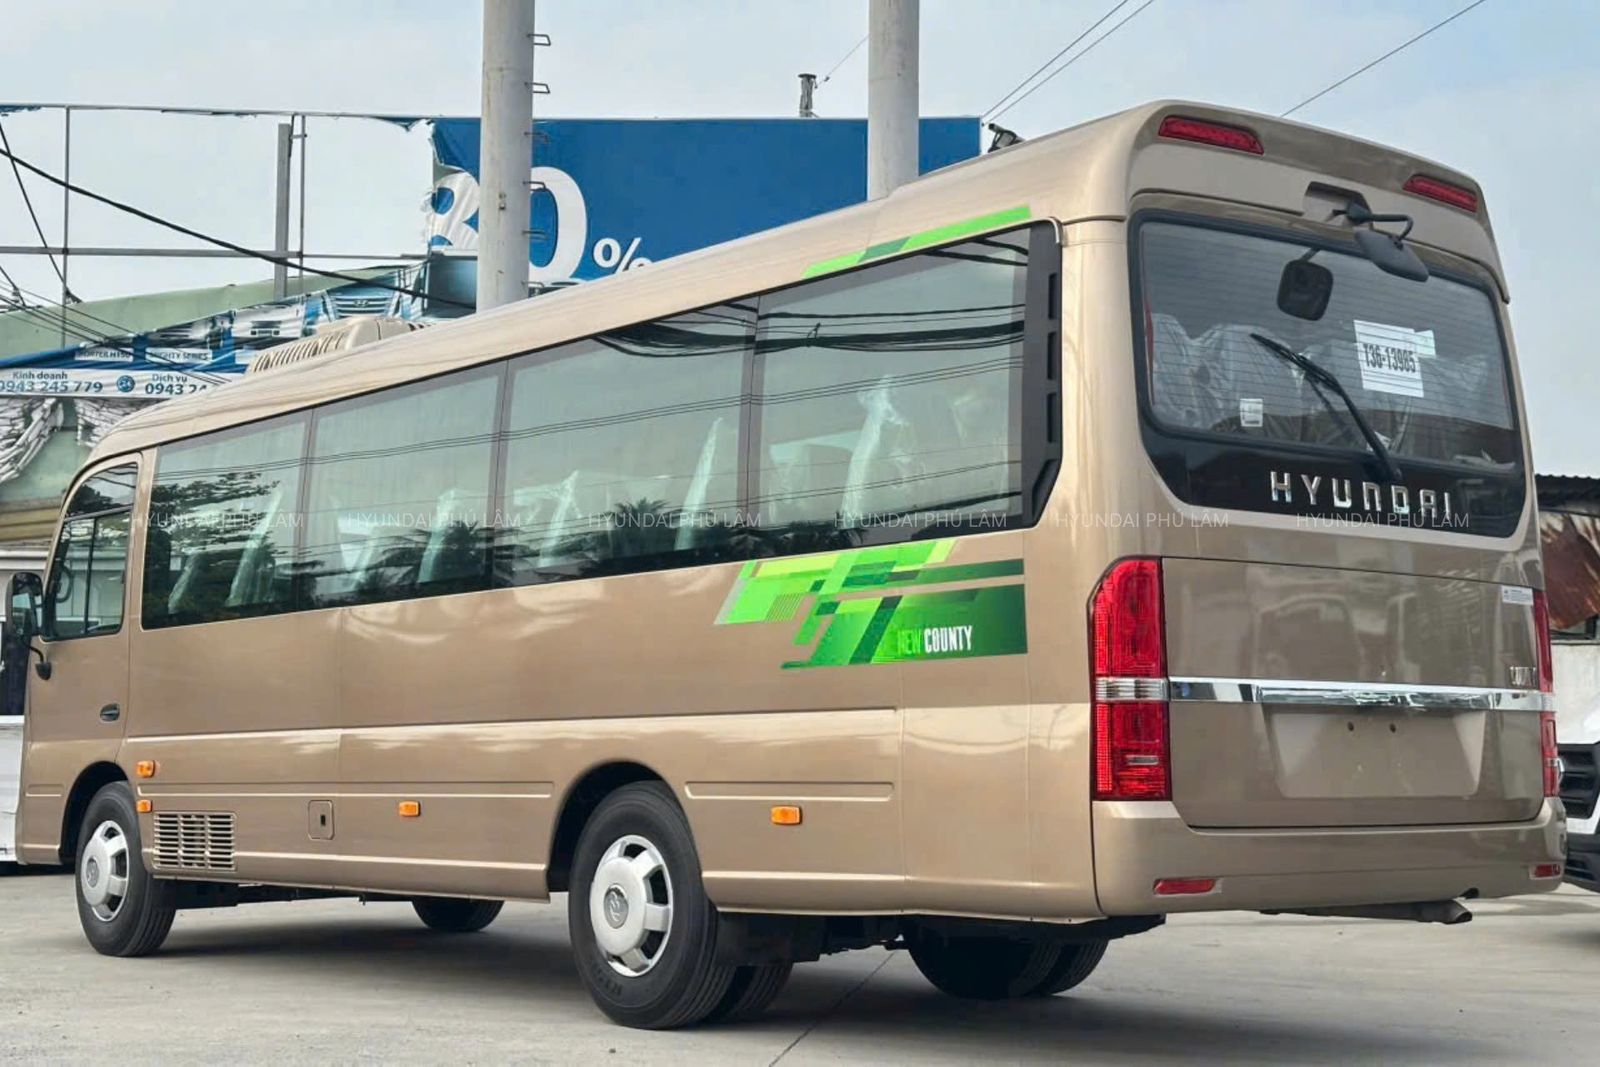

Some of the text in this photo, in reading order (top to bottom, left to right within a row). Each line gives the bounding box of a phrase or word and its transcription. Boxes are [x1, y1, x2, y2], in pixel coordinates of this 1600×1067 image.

[1363, 343, 1416, 373] T36-13985
[13, 371, 68, 380] Kinh doanh
[40, 381, 68, 392] 245
[74, 382, 103, 393] 779
[145, 383, 184, 395] 0943
[1270, 471, 1451, 519] HYUNDAI
[923, 625, 972, 653] COUNTY
